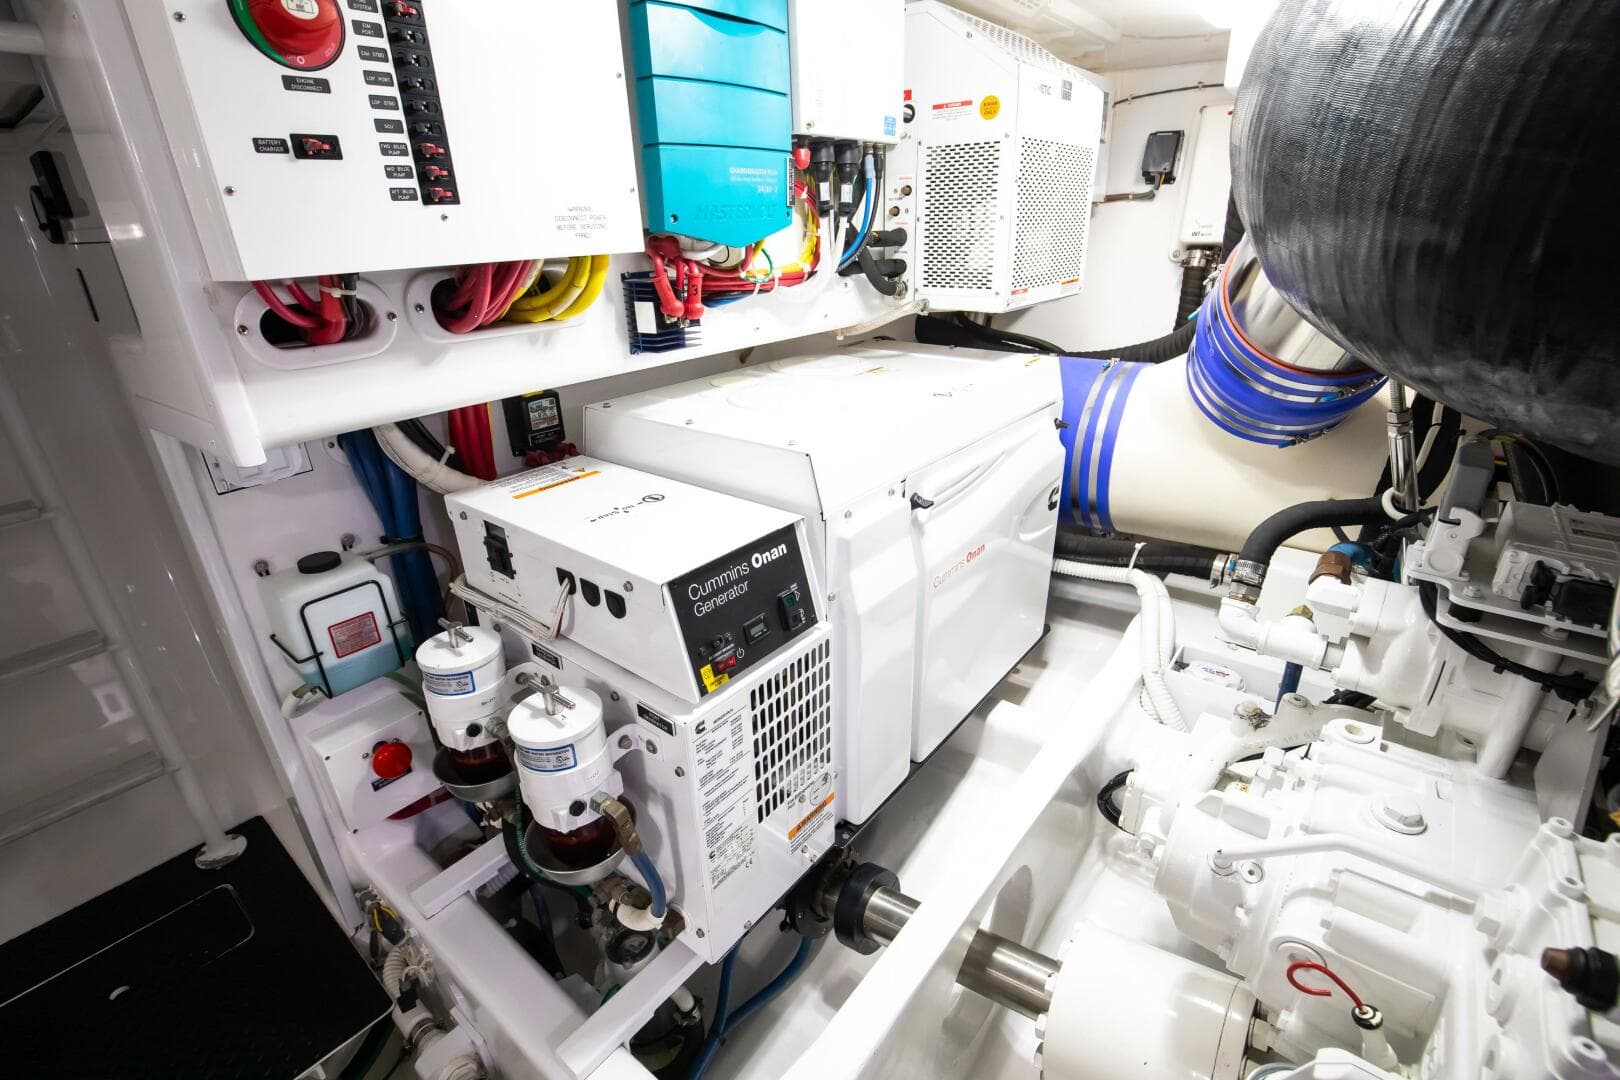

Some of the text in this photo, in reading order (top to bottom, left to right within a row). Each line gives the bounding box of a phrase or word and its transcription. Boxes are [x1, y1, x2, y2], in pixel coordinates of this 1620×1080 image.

[291, 84, 322, 92] DISCONNECT
[688, 543, 787, 601] Cummins Onan
[933, 543, 985, 589] Cummins Onan
[694, 581, 750, 617] Generator
